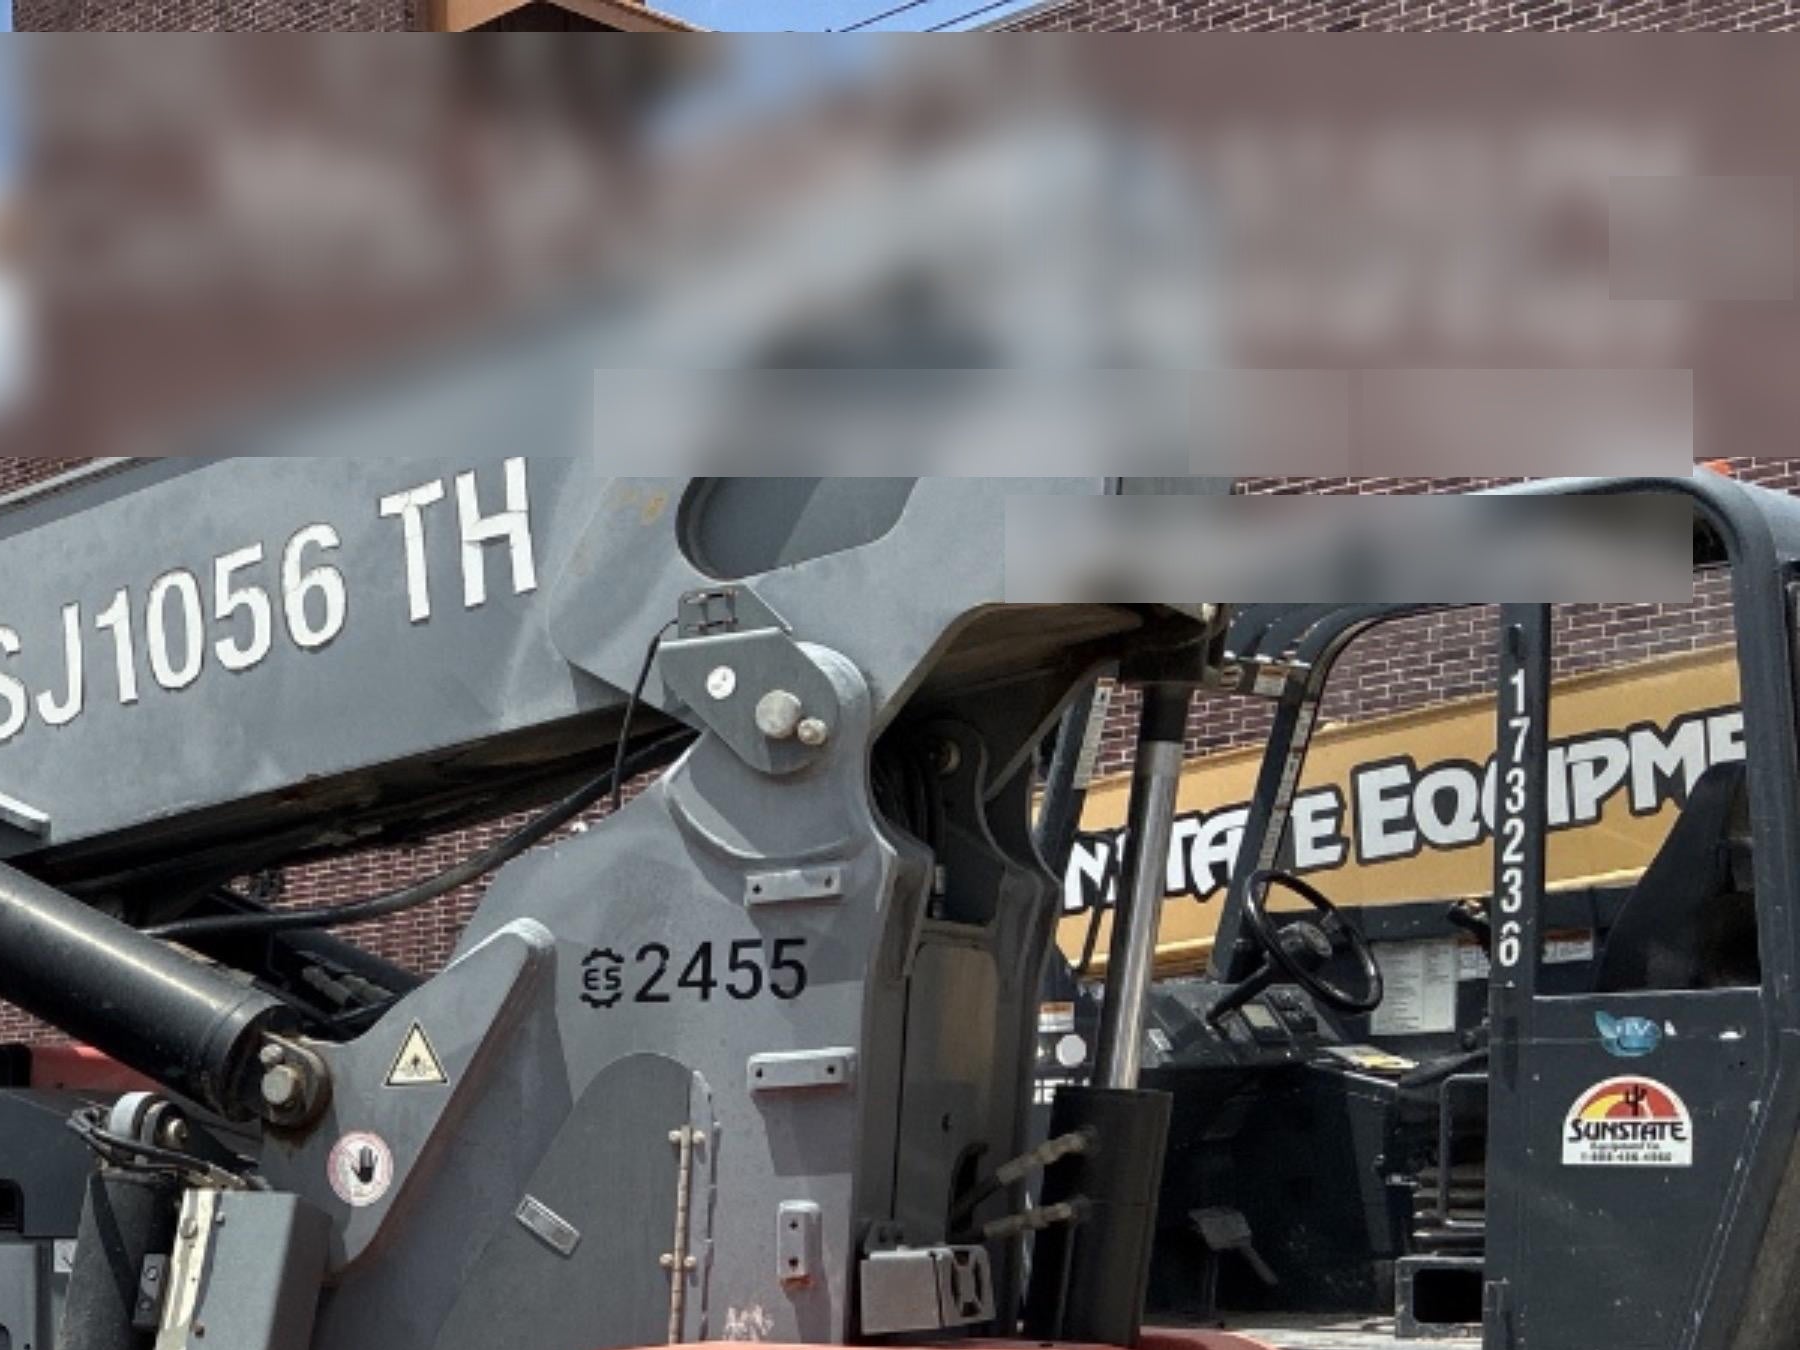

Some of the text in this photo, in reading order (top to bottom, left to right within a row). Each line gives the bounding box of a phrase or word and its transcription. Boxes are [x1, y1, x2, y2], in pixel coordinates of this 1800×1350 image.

[379, 457, 537, 623] TH
[1357, 711, 1747, 860] EQIPM
[1498, 668, 1531, 967] 173236
[634, 937, 808, 1003] 2455
[1568, 1118, 1688, 1143] SUNSTATE
